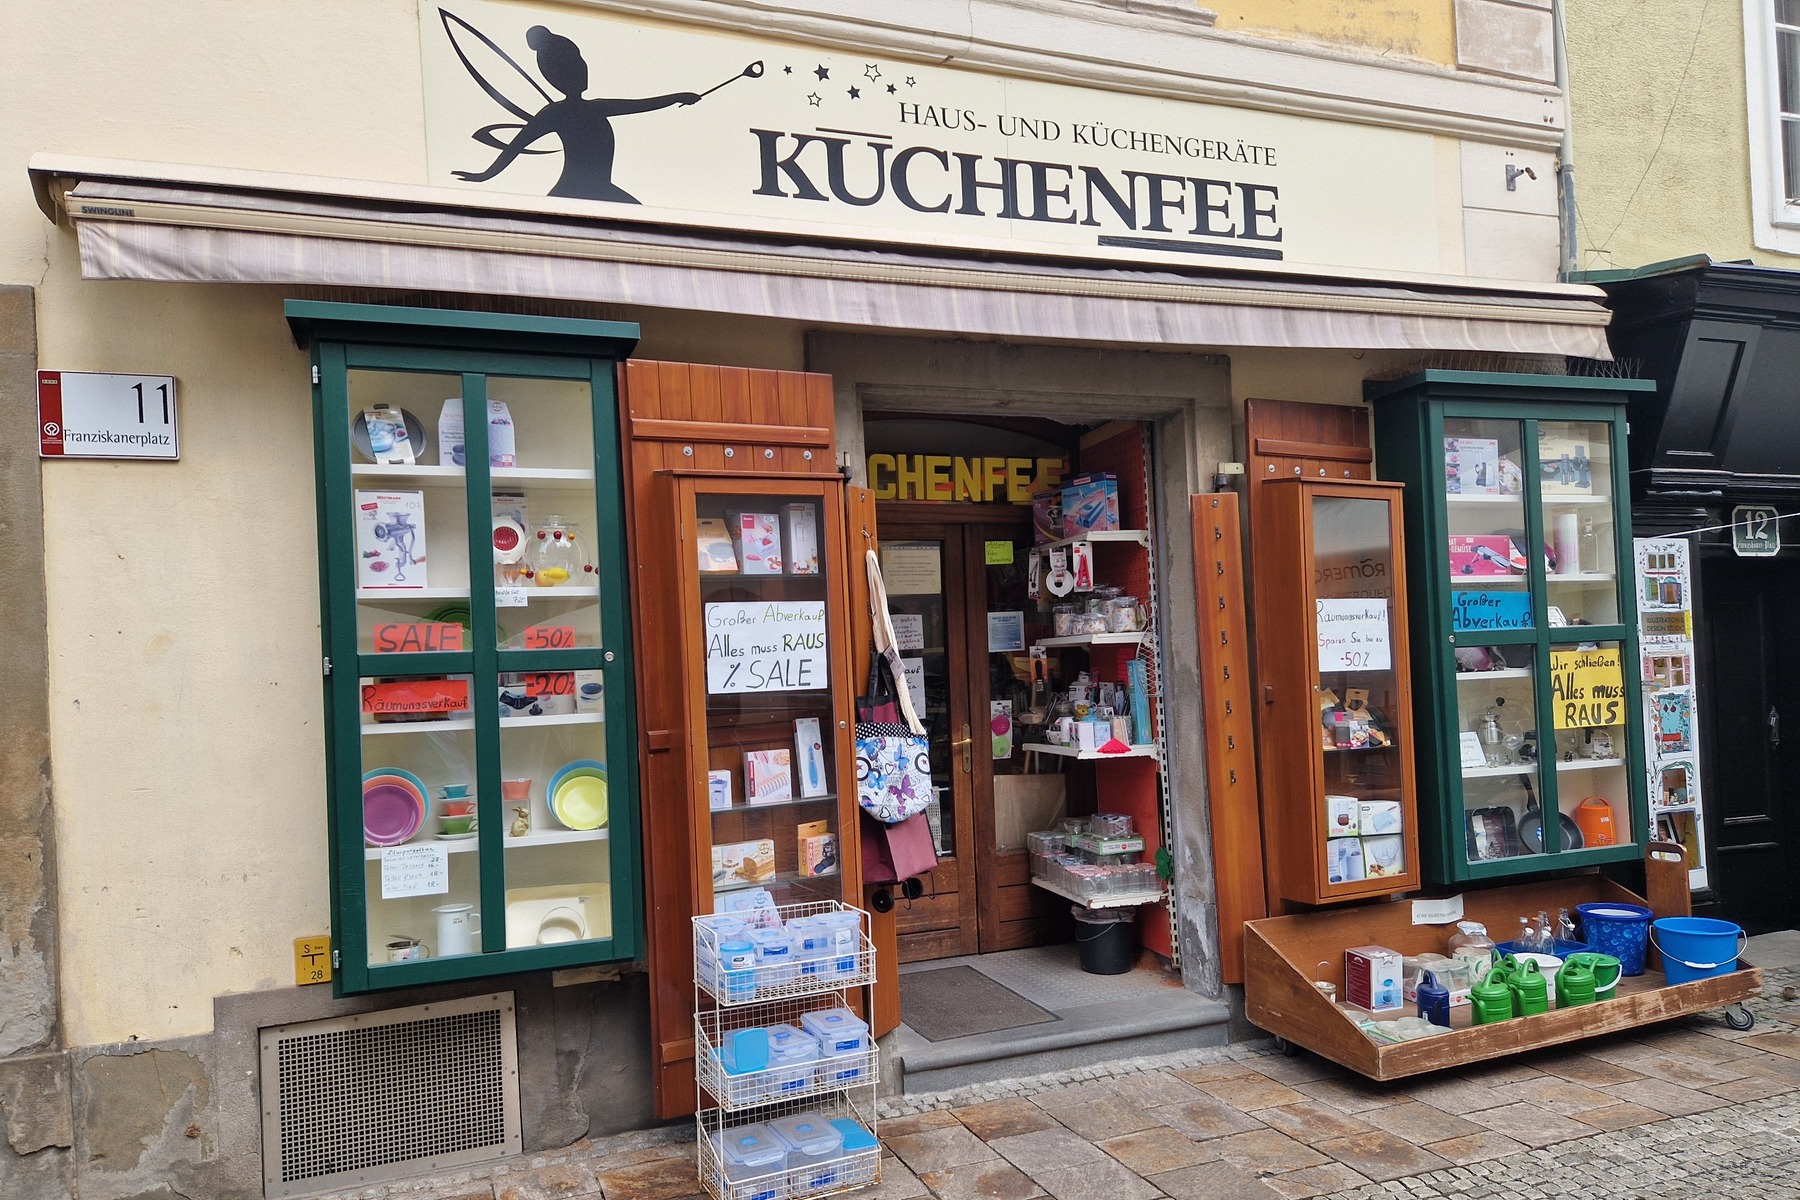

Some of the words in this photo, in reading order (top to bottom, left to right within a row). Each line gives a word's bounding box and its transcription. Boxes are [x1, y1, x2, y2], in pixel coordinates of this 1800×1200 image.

[899, 101, 987, 132] HAUS-
[997, 114, 1061, 141] UND
[1072, 122, 1278, 167] KÜCHENGERÄTE
[749, 127, 1284, 243] KÜCHENFEE
[81, 205, 135, 217] SWINGLINE
[131, 382, 170, 425] 11
[63, 428, 170, 448] Franziskanerplatz
[1745, 510, 1768, 540] 12
[1457, 591, 1502, 609] Großer
[707, 605, 757, 629] Großer
[762, 603, 825, 624] Abverkauf
[1452, 606, 1531, 629] Abverkauf
[378, 624, 460, 653] SALE
[526, 627, 574, 650] -50%
[707, 633, 745, 659] Alles
[750, 643, 778, 655] muss
[781, 632, 825, 652] RAUS
[1318, 632, 1347, 650] Sparen
[1350, 631, 1361, 644] Sie
[526, 672, 575, 697] -20%
[746, 658, 813, 689] SALE
[1552, 672, 1585, 701] Alles
[1592, 683, 1625, 699] muss
[1565, 700, 1619, 727] RAUS
[303, 943, 311, 954] S
[310, 969, 324, 980] 28
